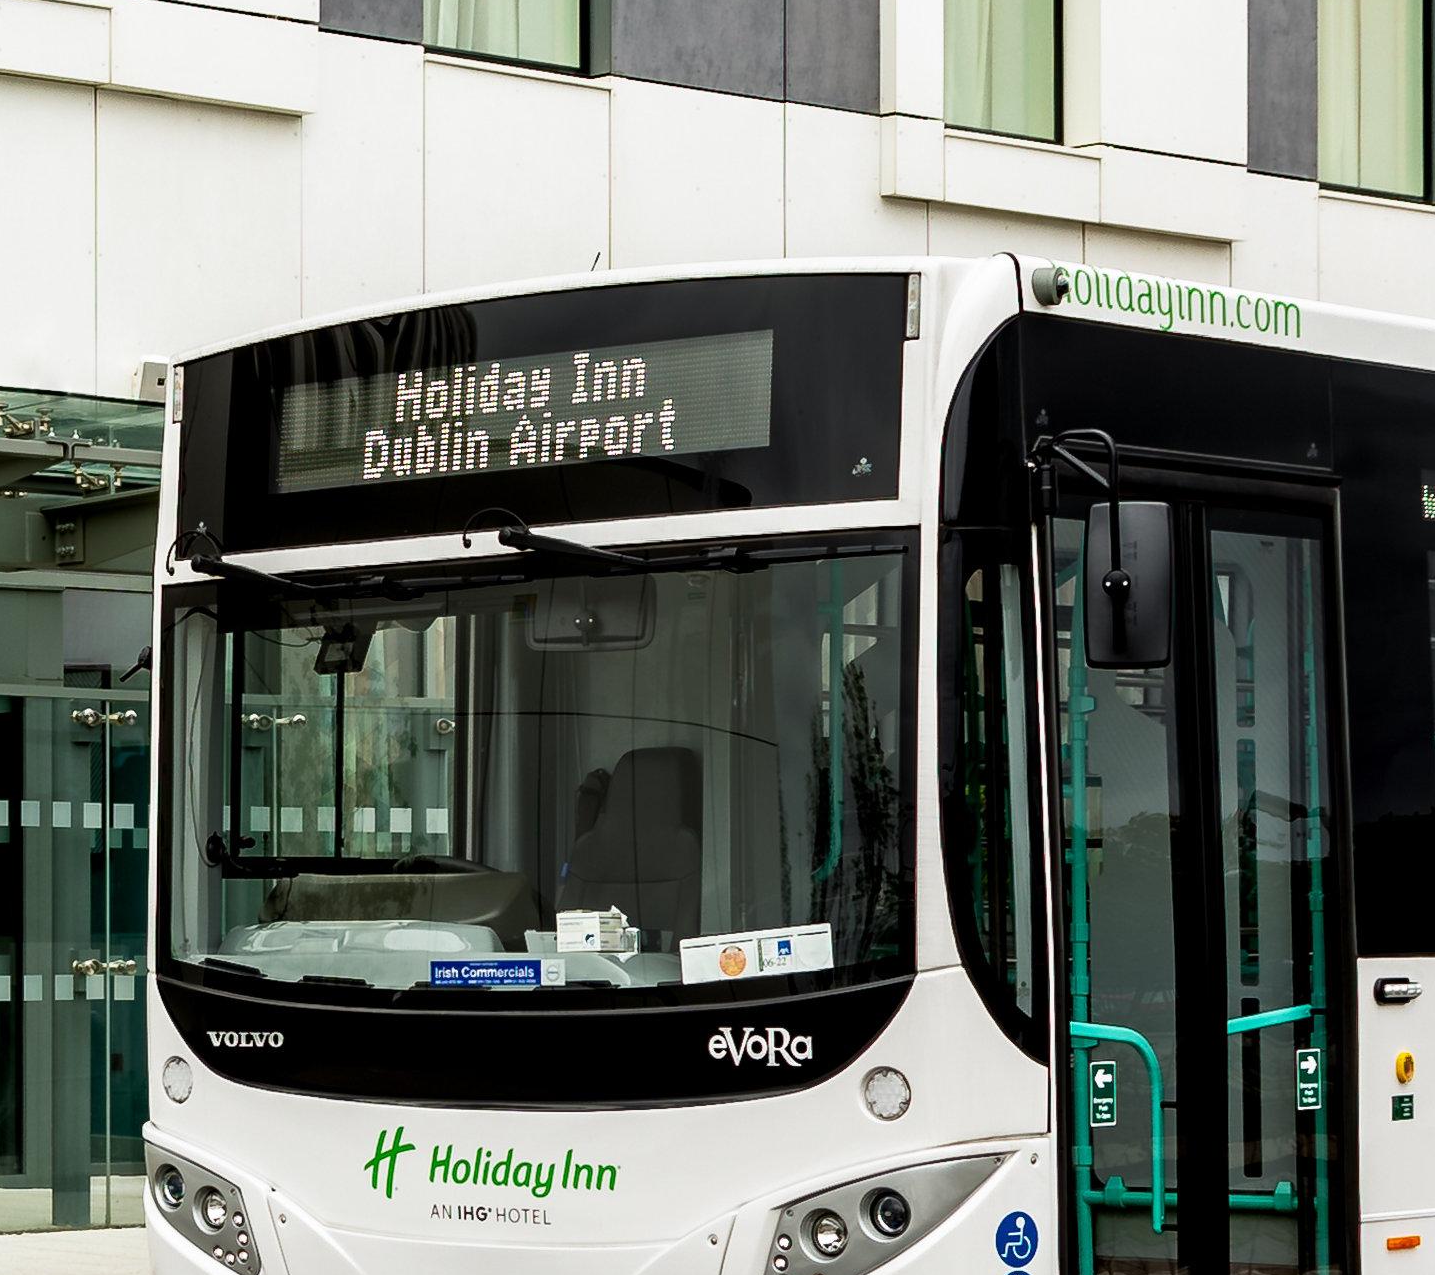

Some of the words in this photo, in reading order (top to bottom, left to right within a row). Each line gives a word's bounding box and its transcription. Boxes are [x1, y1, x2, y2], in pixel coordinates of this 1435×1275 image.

[395, 362, 551, 422] Holiday
[571, 352, 646, 405] Inn
[362, 421, 489, 480] Dublin
[509, 398, 676, 467] Airport
[435, 966, 459, 979] Irish
[461, 966, 535, 979] Commercials
[206, 1031, 284, 1048] VOLVO
[429, 1144, 556, 1198] Holiday
[430, 1203, 453, 1220] AN
[496, 1207, 552, 1226] HOTEL
